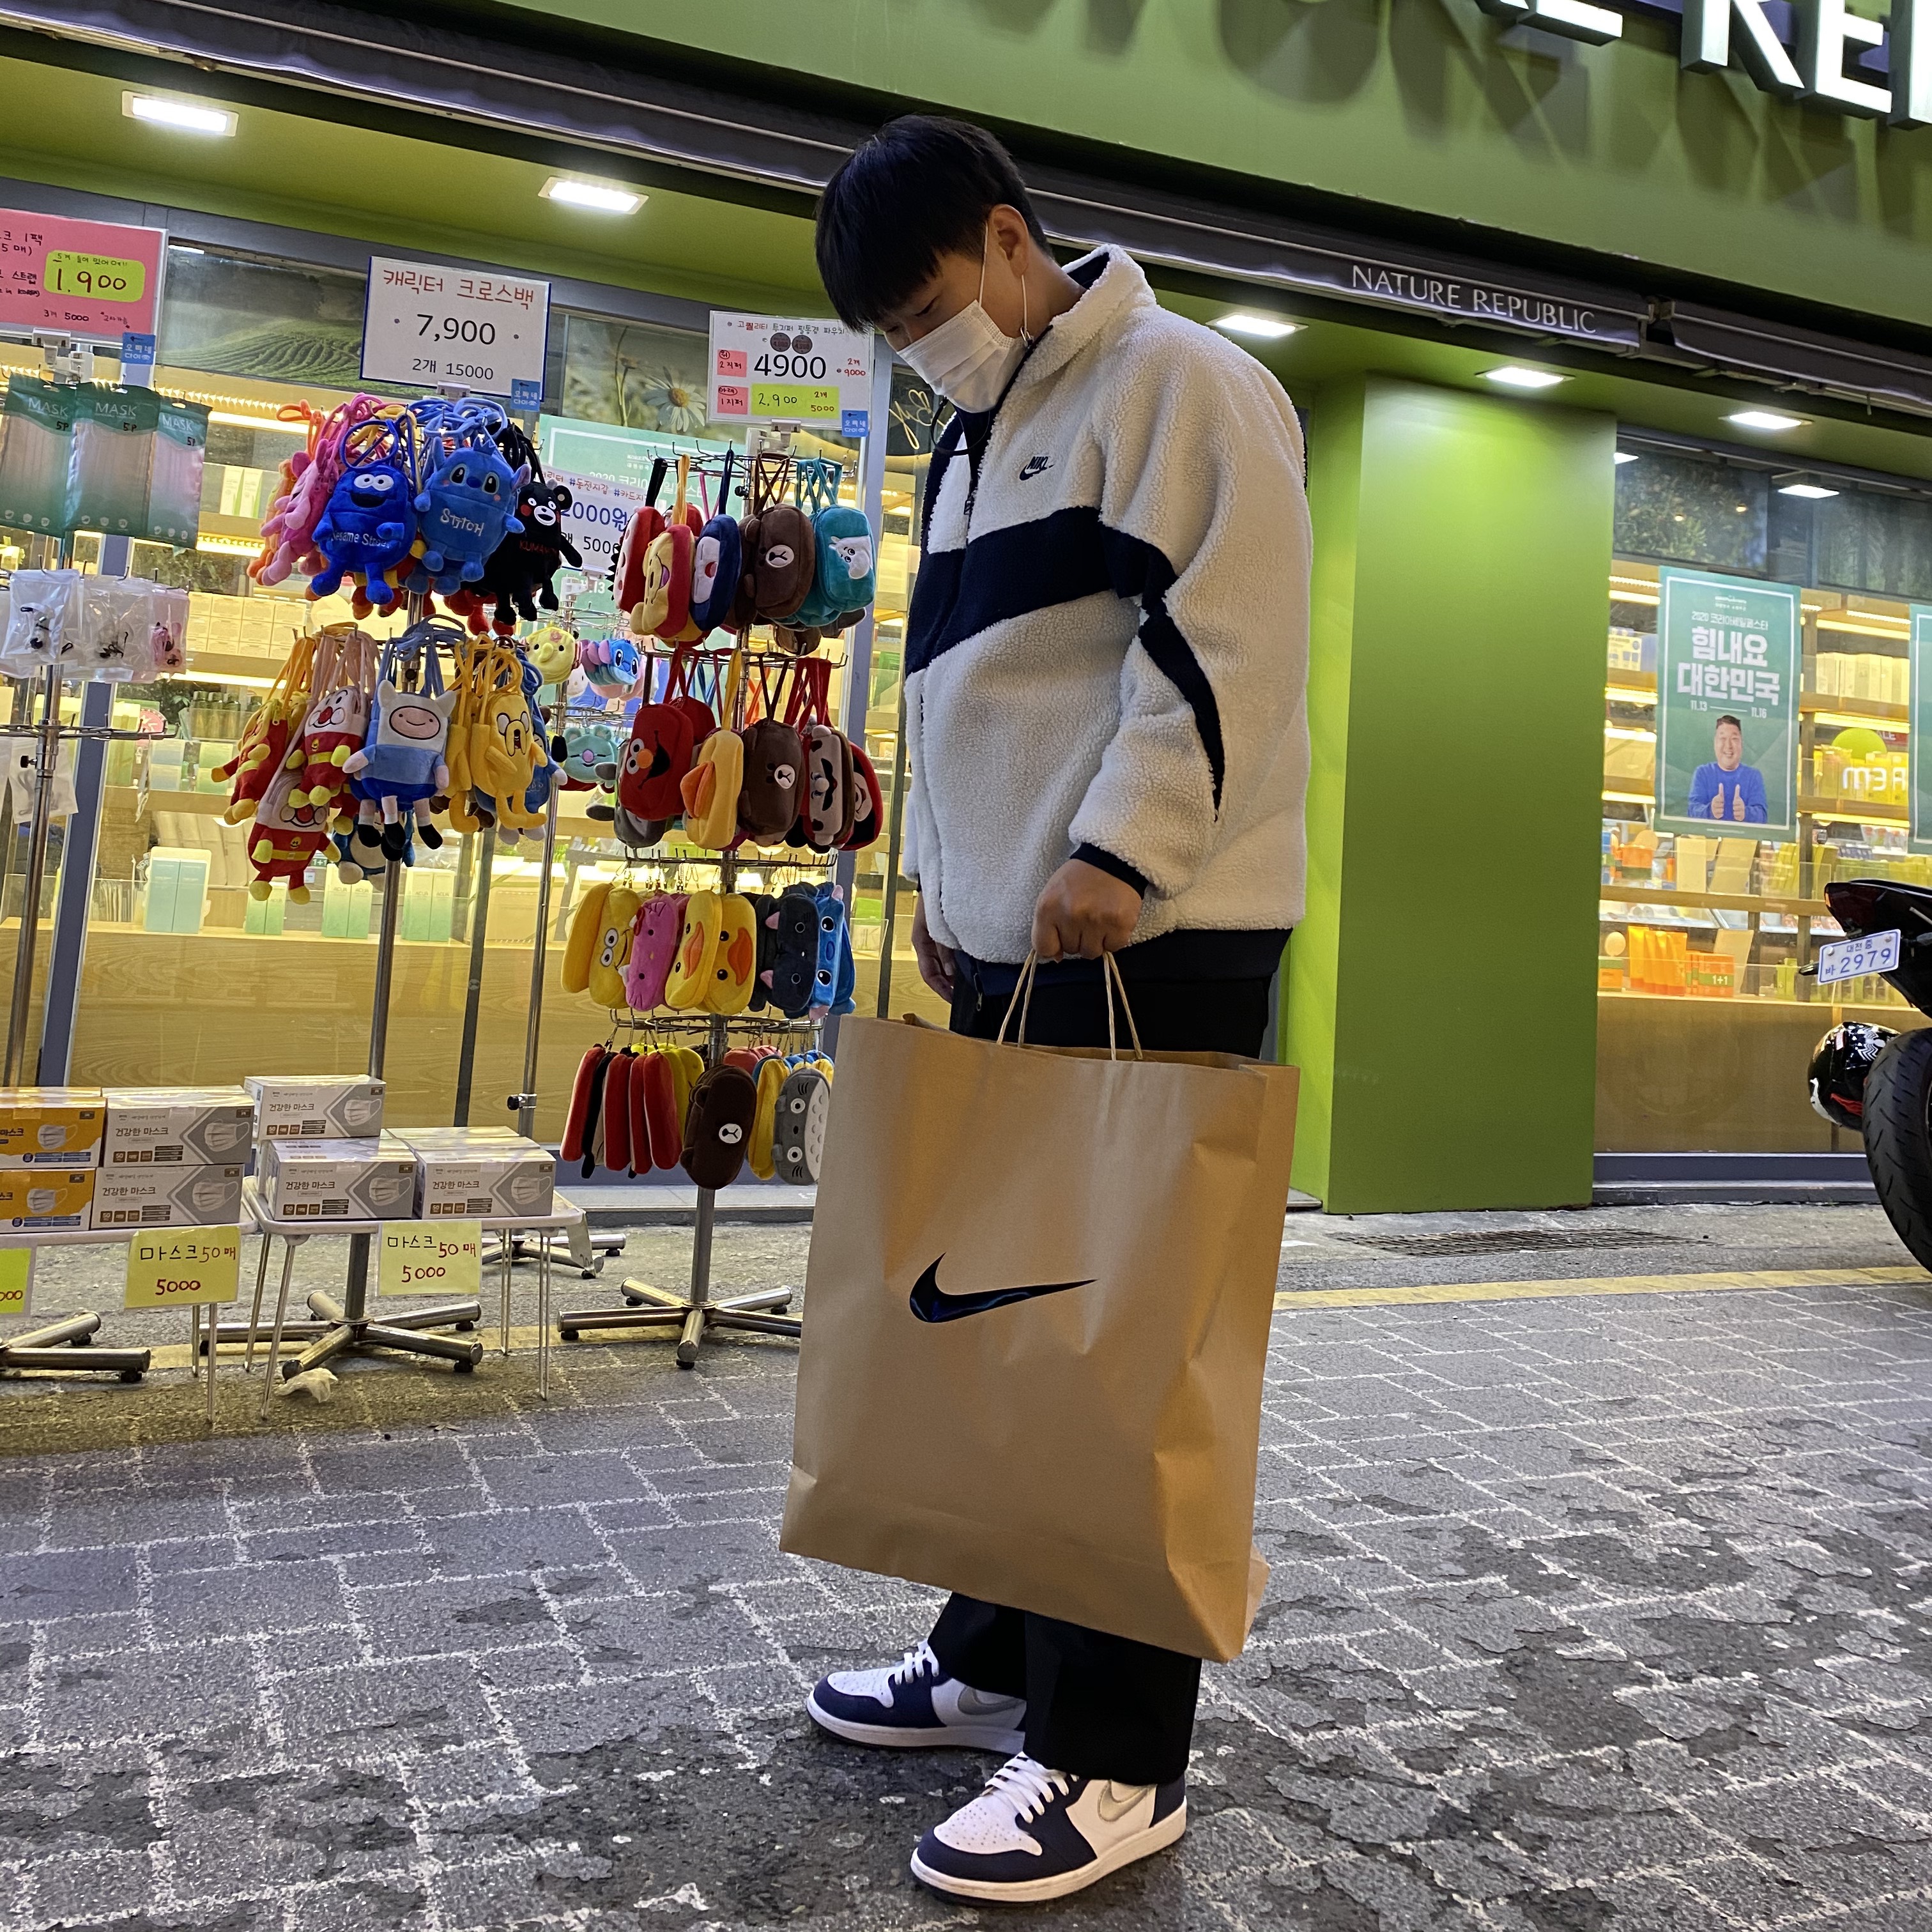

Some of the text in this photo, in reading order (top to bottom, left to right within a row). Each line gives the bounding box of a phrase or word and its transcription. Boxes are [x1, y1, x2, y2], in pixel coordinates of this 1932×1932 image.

[383, 269, 535, 310] 캐릭터 크로스백
[1352, 264, 1597, 334] NATURE REPUBLIC
[65, 312, 89, 322] 5000
[416, 313, 496, 345] 7,900
[772, 323, 794, 332] 투지퍼
[412, 358, 494, 381] 2개 15000
[753, 353, 827, 379] 4900
[847, 358, 861, 366] 2개
[29, 397, 68, 417] MASK
[96, 402, 137, 417] MASK
[56, 421, 69, 431] 5P
[162, 415, 193, 431] MASK
[1026, 456, 1049, 471] NIKE
[569, 477, 610, 495] #동전지갑
[613, 487, 647, 502] #카드지
[560, 500, 627, 533] 000원
[1690, 625, 1768, 668] 힘내요
[1676, 662, 1781, 706] 대한민국
[1690, 700, 1767, 719] 11.13 11.16
[1825, 947, 1891, 976] 바 2979
[1712, 975, 1729, 985] 1+1
[269, 1103, 291, 1112] 건강한
[115, 1127, 169, 1137] 건강한 마스크
[102, 1186, 156, 1196] 건강한 마스크
[286, 1181, 309, 1190] 건강한
[433, 1181, 456, 1190] 건강한
[401, 1266, 446, 1283] 5000
[155, 1279, 201, 1296] 5000
